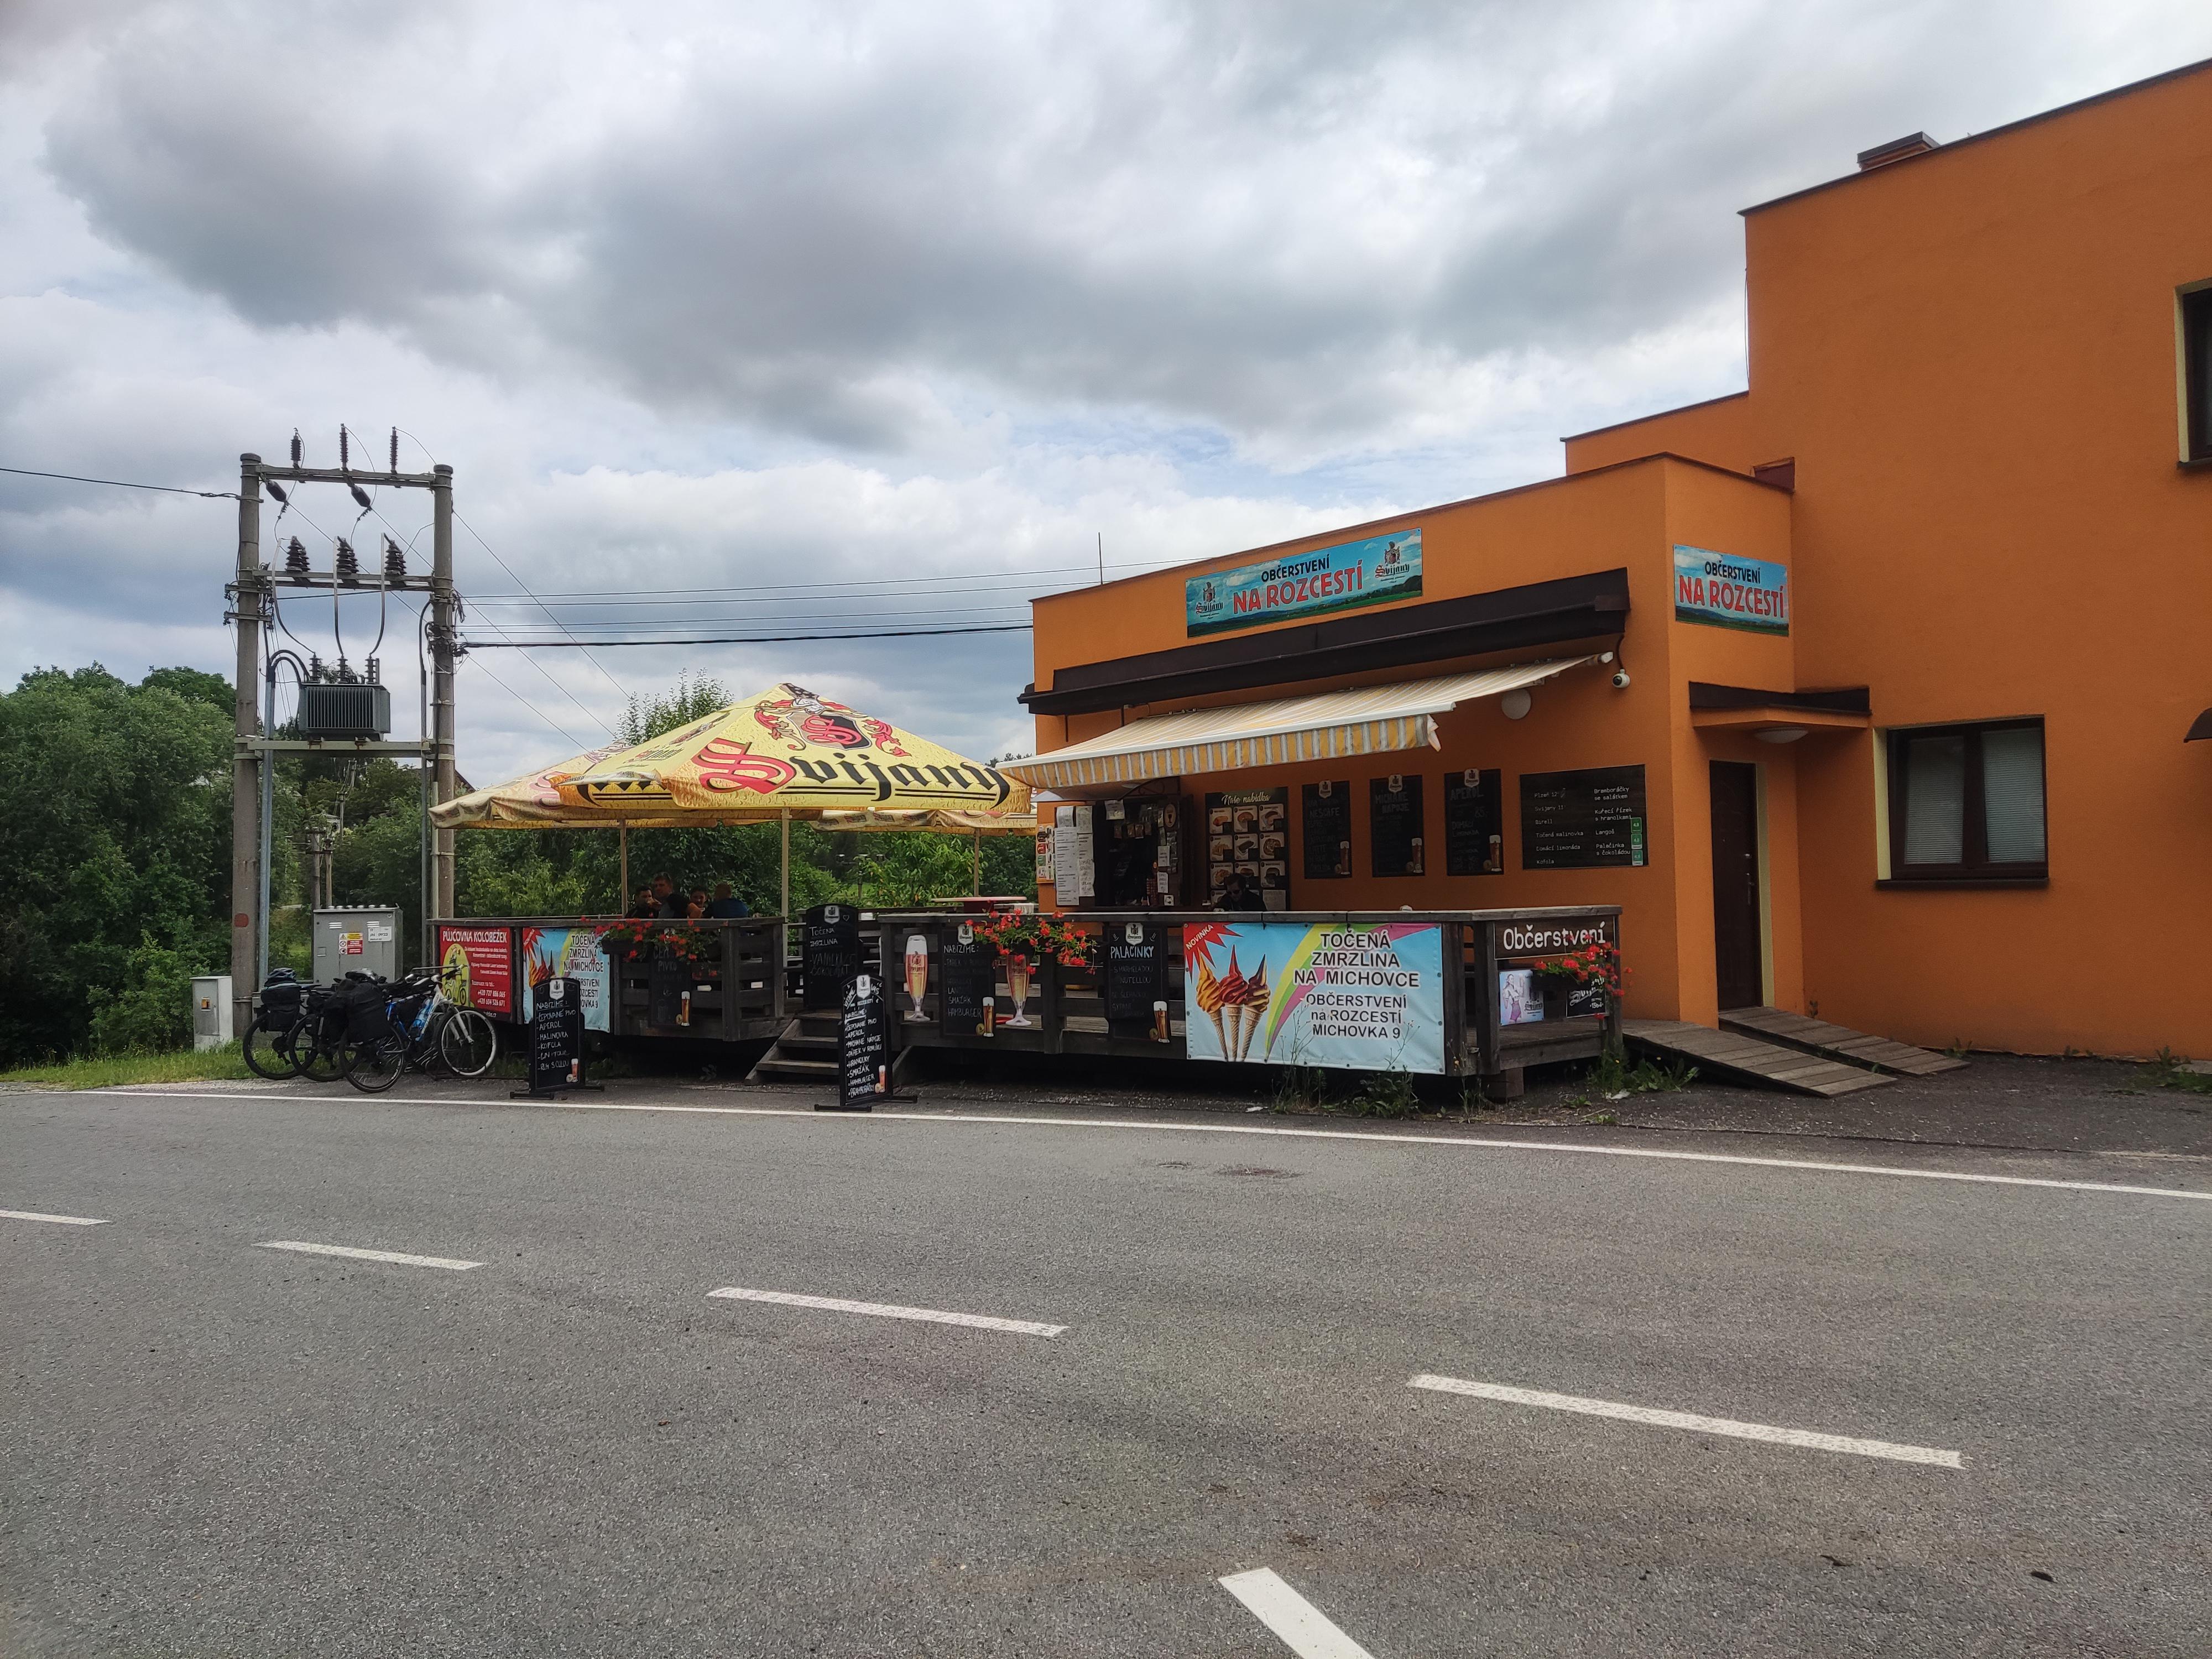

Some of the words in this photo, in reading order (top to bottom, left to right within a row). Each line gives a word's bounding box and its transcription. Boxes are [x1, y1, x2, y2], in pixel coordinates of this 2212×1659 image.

[1261, 554, 1329, 582] OBČERSTVENÍ
[1375, 564, 1410, 578] Svijany
[1705, 560, 1761, 584] OBČERSTVENÍ
[1234, 588, 1261, 614] NA
[1266, 560, 1363, 608] ROZCESTÍ
[1679, 575, 1705, 606] NA
[1709, 586, 1784, 618] ROZCESTÍ
[691, 737, 1011, 808] Svijany
[1594, 786, 1630, 794] Bramboráčky
[442, 928, 473, 942] PŮJČOVNA
[473, 929, 508, 943] KOLOBĚŽEK
[571, 931, 596, 945] TOČENÁ
[1186, 924, 1214, 951] NOVINKA
[1321, 927, 1390, 950] TOČENÁ
[1503, 921, 1606, 950] Občerstvení
[569, 947, 597, 959] ZMRZLINA
[1312, 952, 1400, 968] ZMRZLINA
[564, 961, 571, 971] NA
[574, 961, 604, 972] MICHOVCE
[1294, 970, 1316, 985] NA
[1327, 971, 1420, 988] MICHOVCE
[1306, 991, 1407, 1009] OBČERSTVENÍ
[1311, 1010, 1326, 1021] na
[1330, 1010, 1402, 1024] ROZCESTÍ
[539, 1021, 562, 1031] APEROL
[1313, 1024, 1388, 1038] MICHOVKA
[1392, 1027, 1401, 1039] 9
[540, 1031, 568, 1041] MALINOVKA
[847, 1029, 865, 1039] APEROL
[540, 1041, 561, 1050] KOFOLA
[848, 1055, 871, 1068] HRANOLKY
[849, 1063, 870, 1078] SMAŽÁK
[850, 1073, 875, 1087] HAMBURGER
